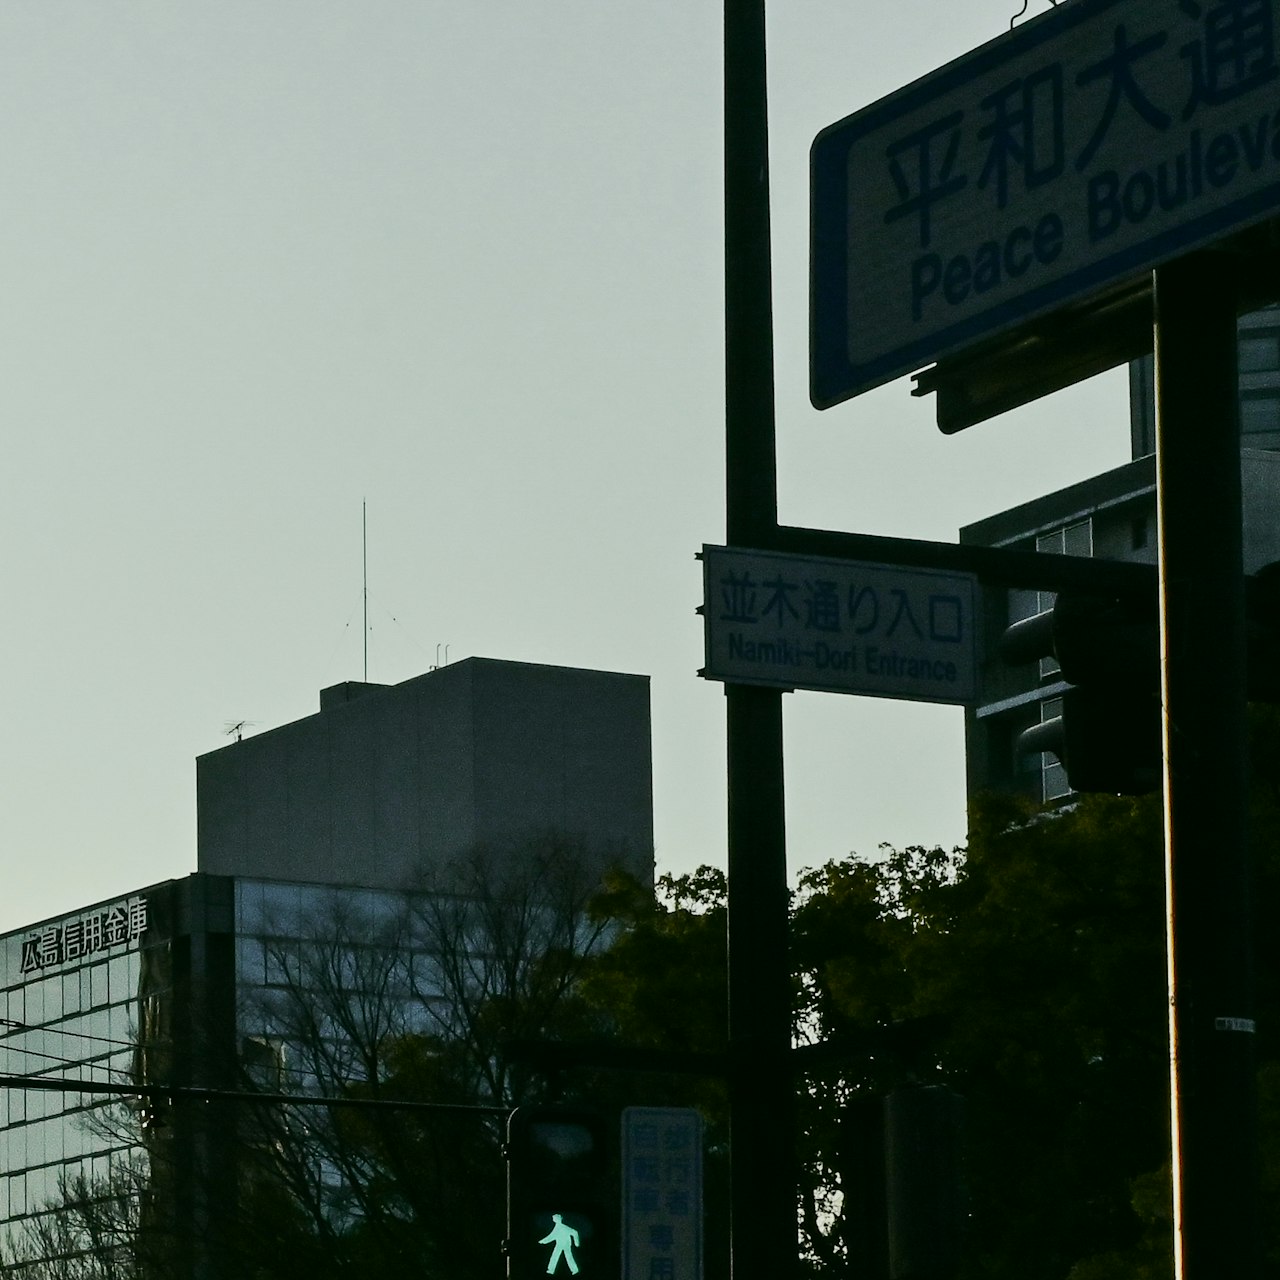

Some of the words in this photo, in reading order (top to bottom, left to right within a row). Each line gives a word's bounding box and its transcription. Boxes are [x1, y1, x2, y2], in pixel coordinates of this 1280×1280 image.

[912, 213, 1063, 322] Peace
[720, 569, 962, 643] 並木通り入口
[866, 646, 958, 683] Entrance
[21, 898, 148, 974] 広島信用金庫
